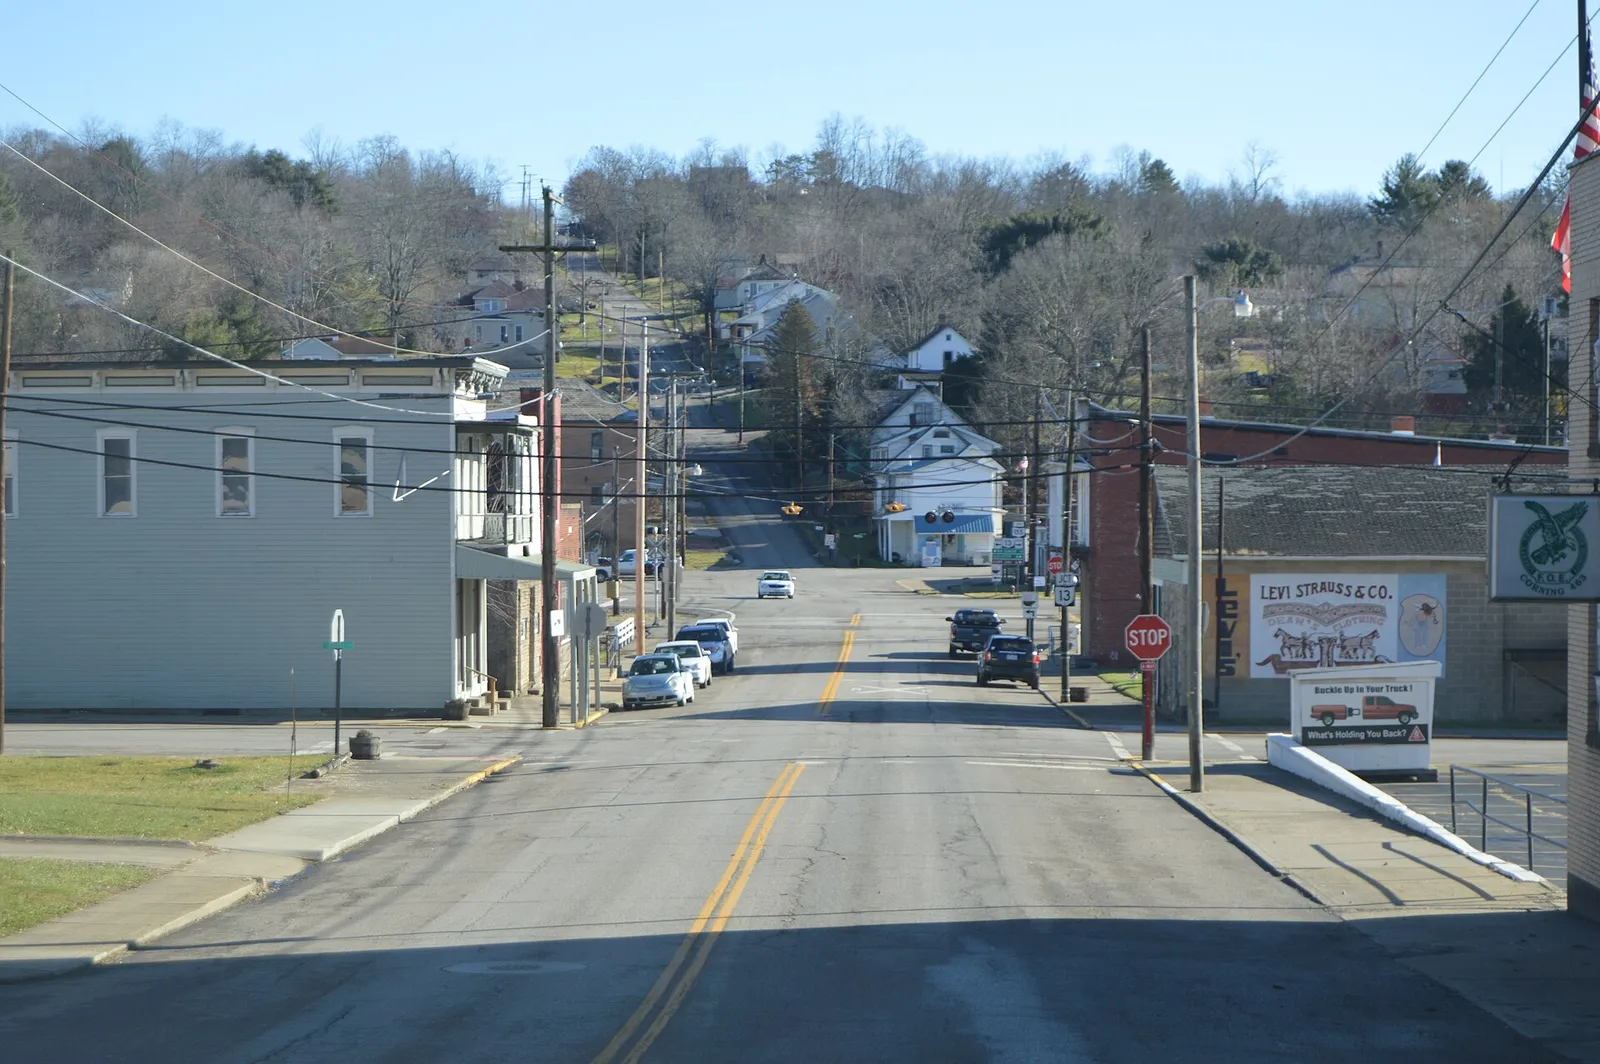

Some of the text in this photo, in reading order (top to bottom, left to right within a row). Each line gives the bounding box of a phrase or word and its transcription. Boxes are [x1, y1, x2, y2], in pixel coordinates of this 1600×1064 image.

[1049, 562, 1064, 570] STO
[1521, 573, 1565, 596] CORNING
[1059, 590, 1071, 601] 13
[1261, 586, 1290, 599] LEVI
[1129, 629, 1168, 646] STOP
[1315, 686, 1342, 694] Buckle
[1344, 686, 1354, 694] Up
[1366, 685, 1384, 693] Your
[1386, 684, 1408, 692] Truck
[1308, 729, 1407, 739] What's Holding You Back?
